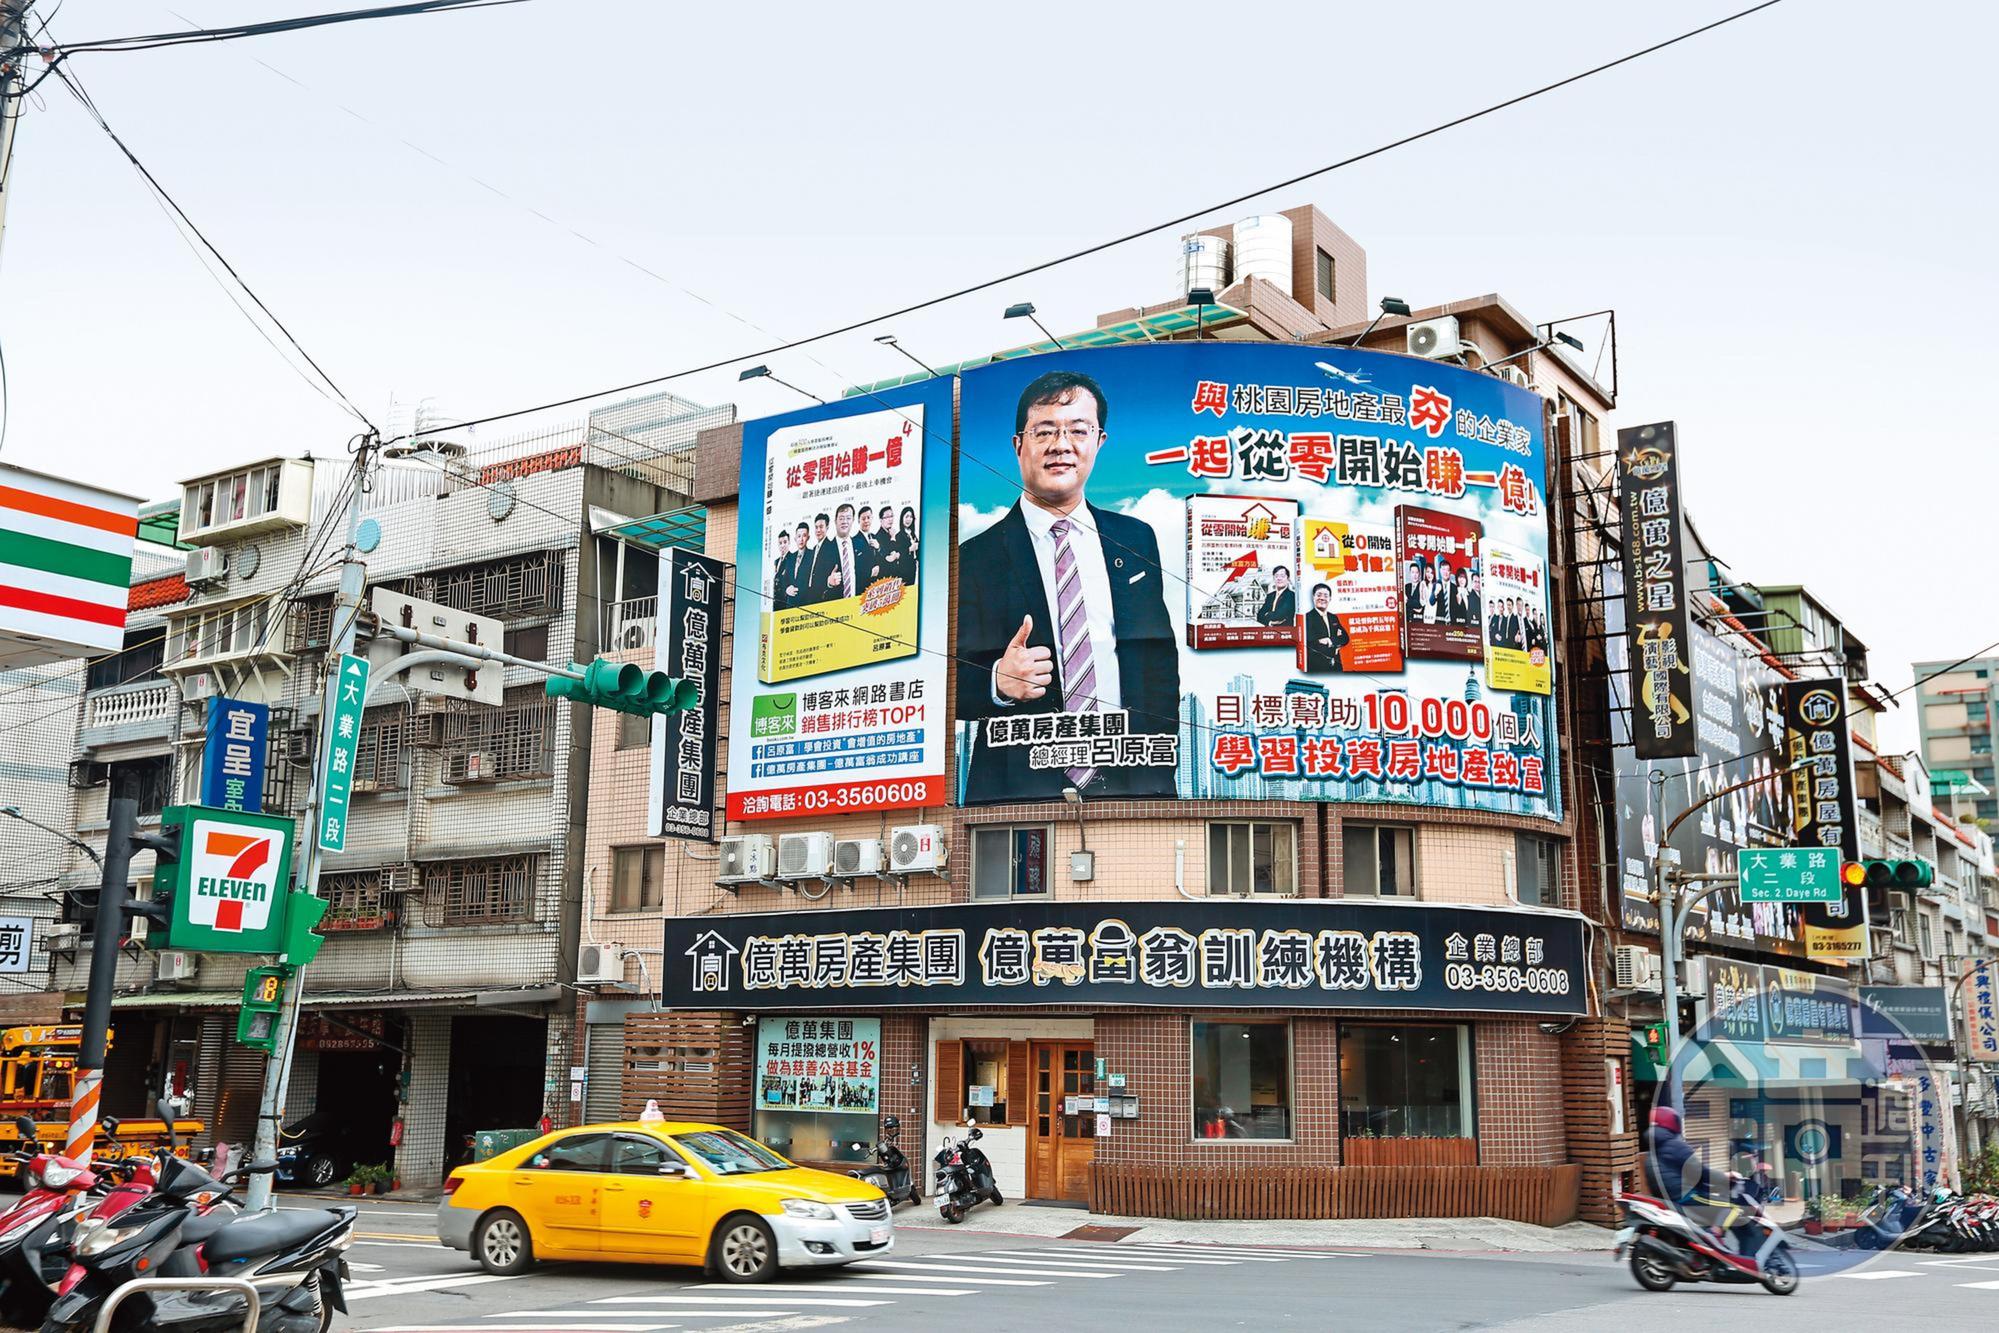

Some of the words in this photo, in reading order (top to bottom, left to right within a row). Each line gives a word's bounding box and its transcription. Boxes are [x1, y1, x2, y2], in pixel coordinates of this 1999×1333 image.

[902, 420, 912, 437] 4
[1193, 381, 1532, 457] 與桃園房地產最夯的企業家
[786, 436, 903, 489] 從零開始賺一億
[1342, 533, 1392, 552] 從0開始
[1629, 491, 1645, 613] www.bs168.com.tw
[1640, 485, 1677, 613] 億萬之星
[802, 679, 925, 711] 博客來網路書店
[1653, 670, 1672, 738] 國際有限公司
[754, 714, 795, 735] 博客來
[801, 704, 925, 734] 銷售排行榜TOP1
[989, 710, 1128, 748] 億萬房產集團
[1214, 692, 1540, 750] 目標幫助10,000個人
[222, 709, 256, 776] 宜呈
[766, 743, 794, 757] 呂原富
[1029, 733, 1178, 769] 總經理呂原富
[325, 680, 360, 843] 大業路二段
[1213, 733, 1544, 794] 學習投資房地產致富
[666, 805, 709, 826] 企業總部
[1812, 730, 1849, 918] 億萬房屋有司
[1751, 852, 1826, 870] 大業路
[1752, 888, 1772, 898] Sec.
[1786, 888, 1811, 900] Daye
[1813, 888, 1827, 898] Rd
[1763, 871, 1815, 885] 二段
[741, 927, 965, 991] 億萬房產集團
[1445, 931, 1544, 964] 企業總部
[1445, 964, 1569, 994] 03-356-0608
[785, 1020, 853, 1041] 億萬集團
[768, 1040, 875, 1060] 每月提撥總營收1%
[766, 1059, 873, 1078] 做為慈善公益基金
